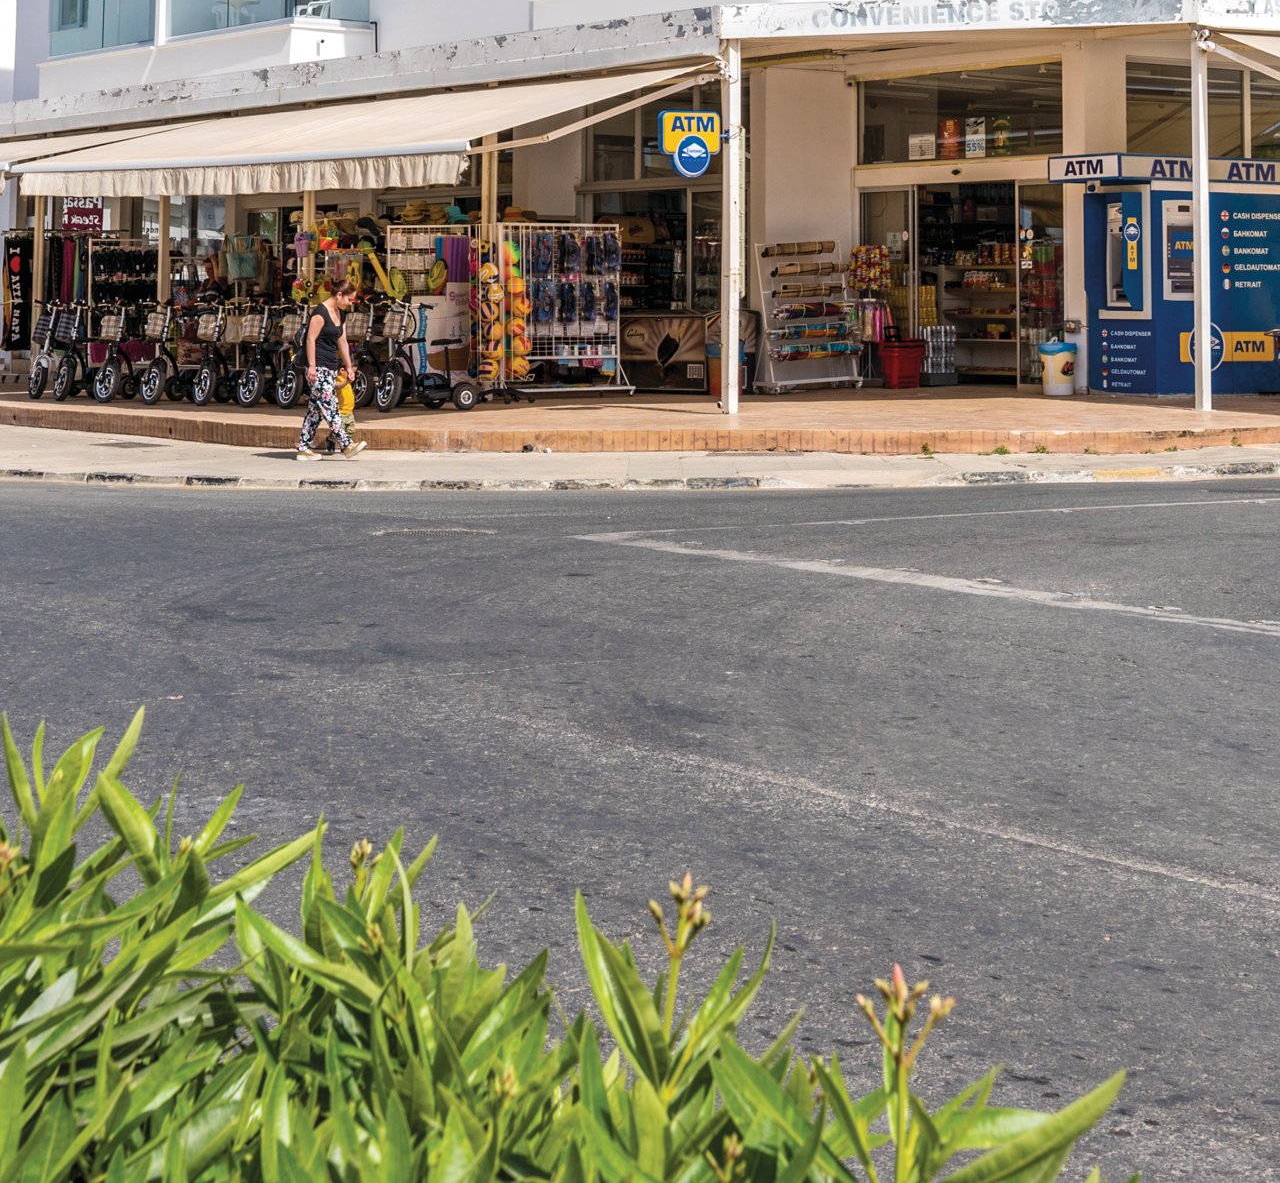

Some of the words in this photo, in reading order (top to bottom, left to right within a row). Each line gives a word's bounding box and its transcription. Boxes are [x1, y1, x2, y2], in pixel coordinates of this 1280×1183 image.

[812, 2, 1001, 28] CONVENIENCE
[671, 116, 715, 132] ATM
[1064, 159, 1104, 176] ATM
[1227, 162, 1276, 181] ATM
[1232, 212, 1250, 220] CASH
[1233, 230, 1268, 238] БАНКОМАТ
[1234, 247, 1269, 255] BANKOMAT
[11, 309, 21, 341] NAPA
[1234, 340, 1265, 353] ATM
